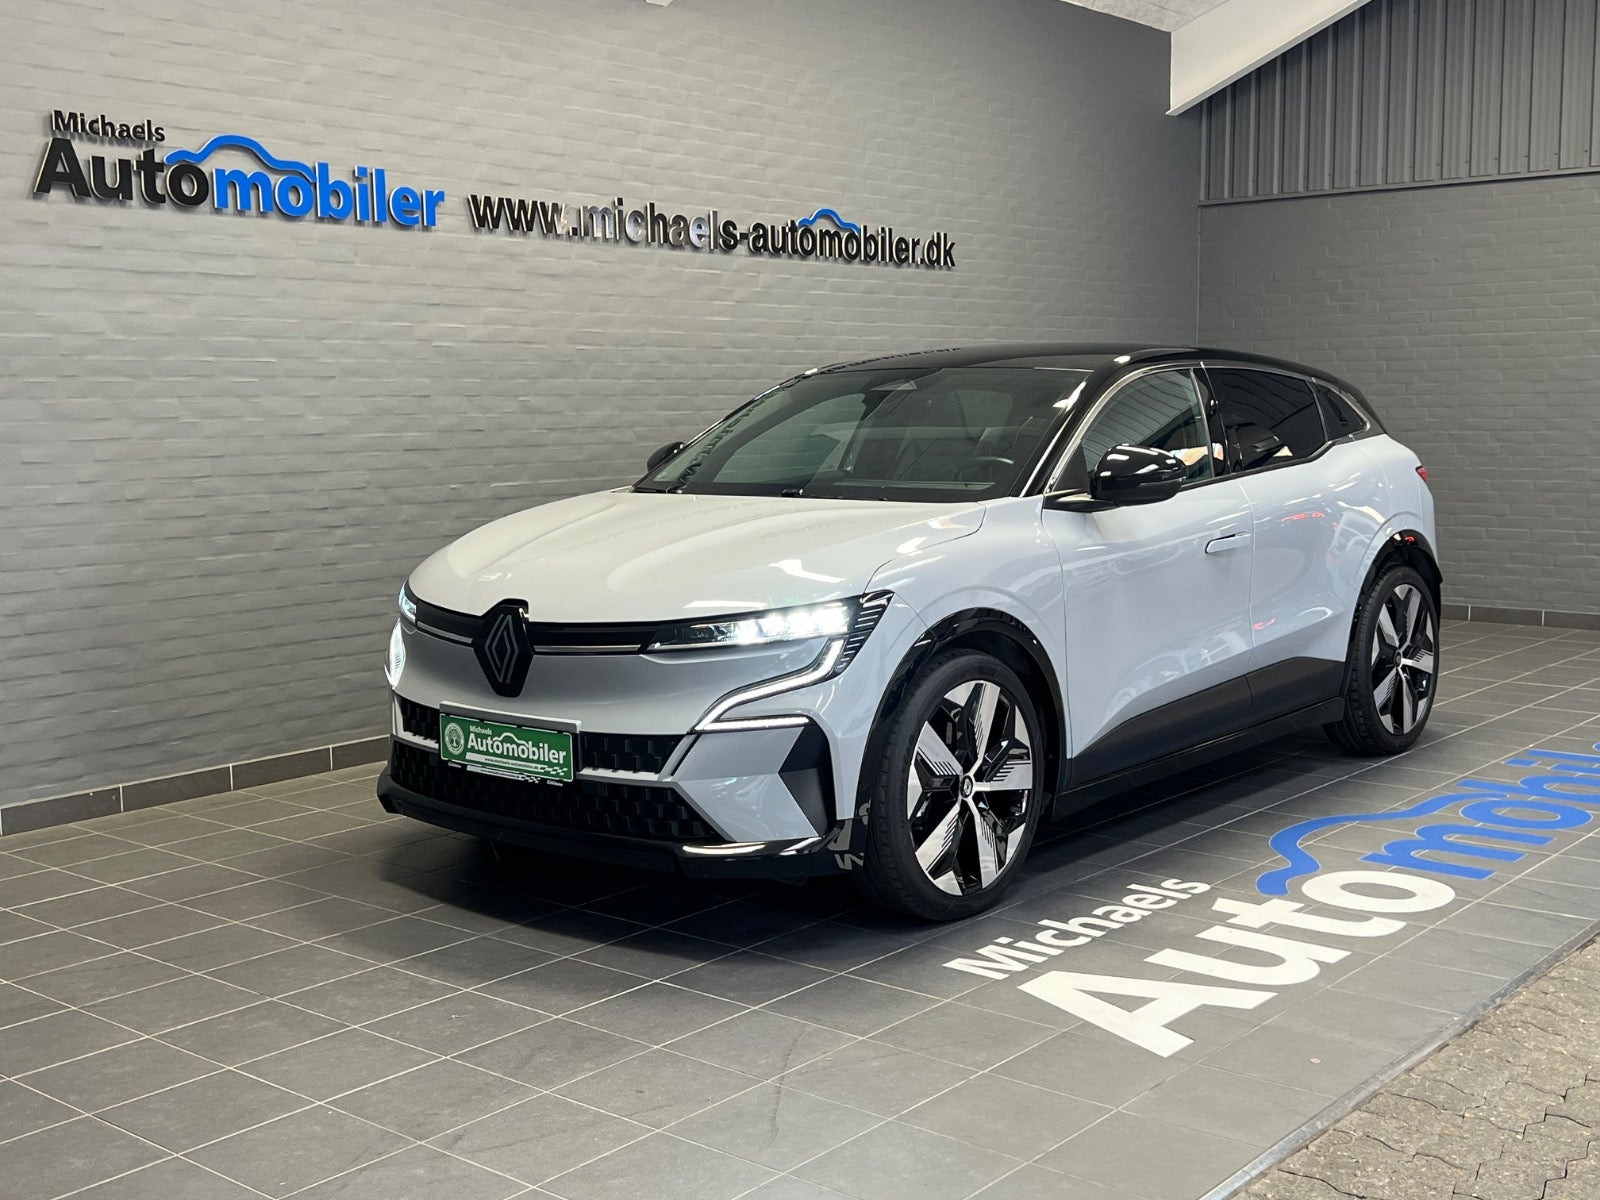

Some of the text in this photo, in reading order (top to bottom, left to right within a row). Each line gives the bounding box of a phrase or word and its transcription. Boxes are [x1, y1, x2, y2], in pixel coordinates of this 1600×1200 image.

[52, 110, 165, 142] Michaels
[33, 137, 445, 226] Automobiler
[468, 194, 955, 267] www.michaels-automobiler.dk
[467, 733, 566, 764] Automobiler
[469, 725, 492, 735] Michaels
[942, 876, 1212, 980] Michaels
